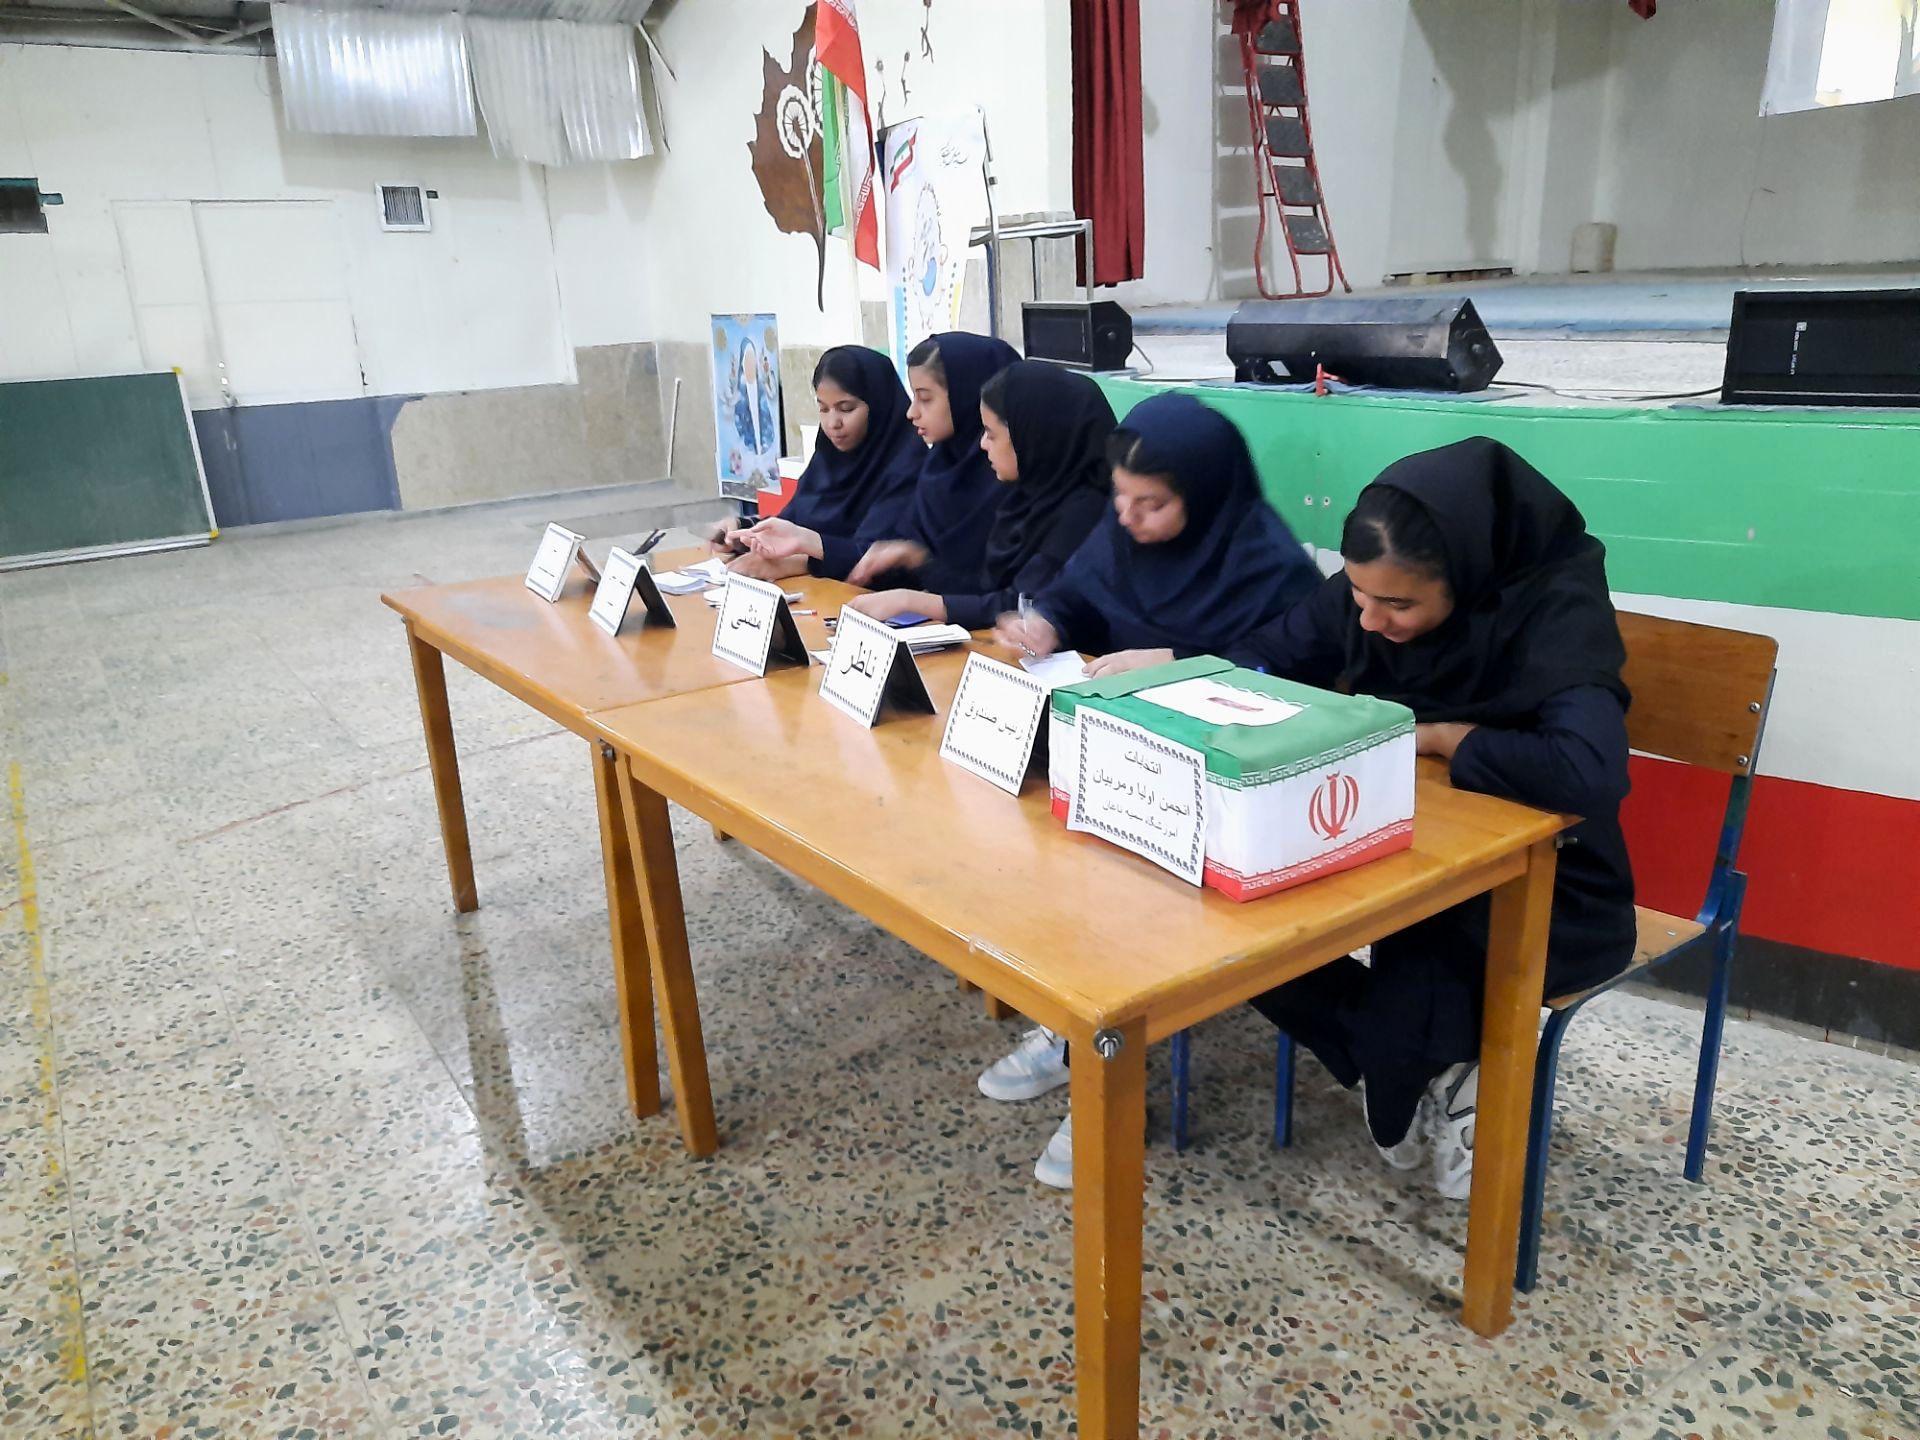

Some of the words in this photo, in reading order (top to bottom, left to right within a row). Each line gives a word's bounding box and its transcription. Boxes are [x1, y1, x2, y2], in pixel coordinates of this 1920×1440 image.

[731, 604, 761, 630] منشی
[839, 640, 877, 679] ناظر
[964, 700, 997, 724] صندوق
[1124, 750, 1162, 775] انتخابات
[1159, 797, 1190, 817] انجمن
